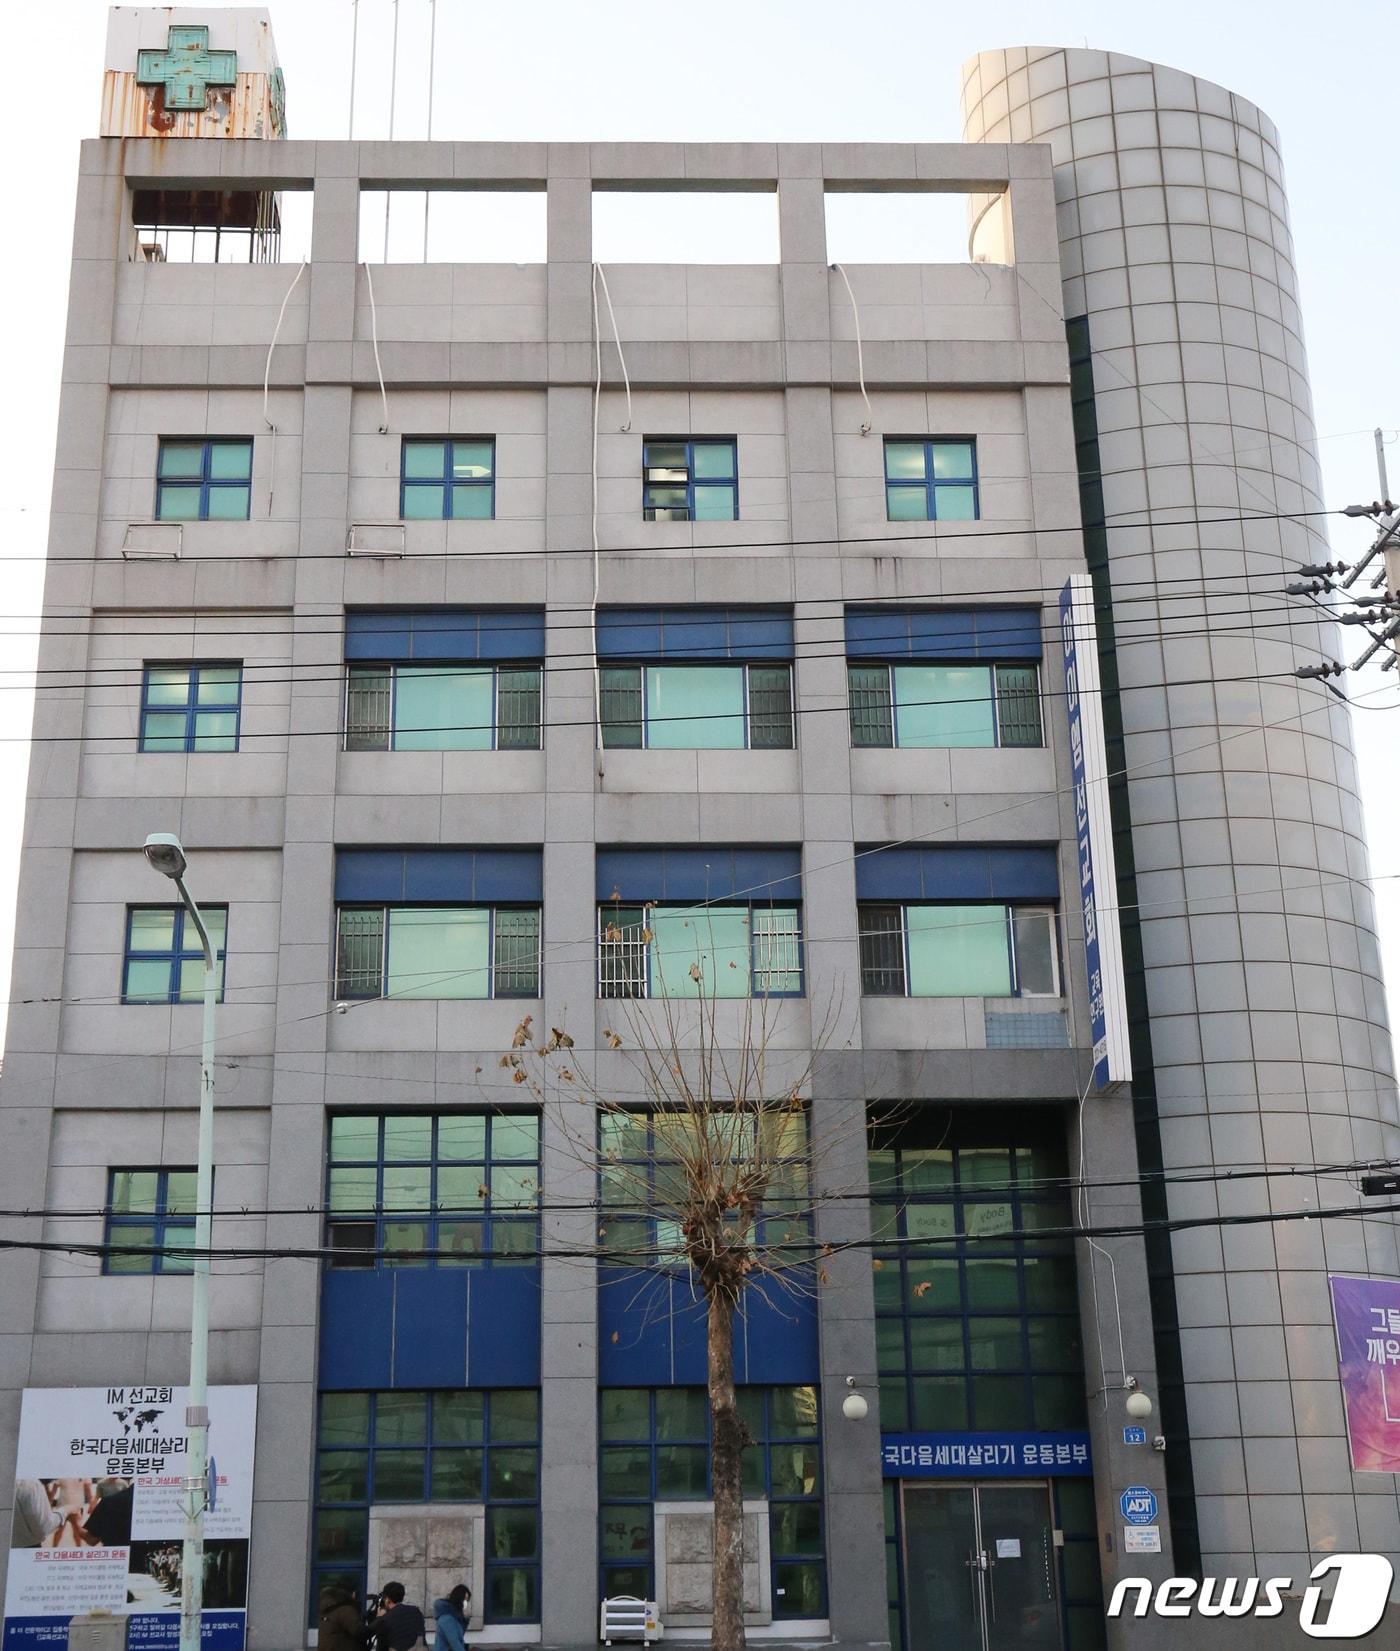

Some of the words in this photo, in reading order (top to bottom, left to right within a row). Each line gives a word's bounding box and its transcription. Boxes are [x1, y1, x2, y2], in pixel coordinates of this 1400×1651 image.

[107, 1388, 124, 1405] IM
[129, 1386, 173, 1405] 선교회
[70, 1437, 189, 1456] 한국다음세대살리
[1129, 1434, 1140, 1442] 12
[881, 1444, 1016, 1467] 국다음세대살리기
[1023, 1443, 1088, 1465] 운동본부
[106, 1457, 165, 1475] 운동본부
[1128, 1498, 1151, 1513] ADT
[35, 1551, 50, 1560] 한국
[53, 1551, 84, 1560] 다음세대
[86, 1550, 109, 1559] 살리기
[111, 1550, 127, 1558] 운동
